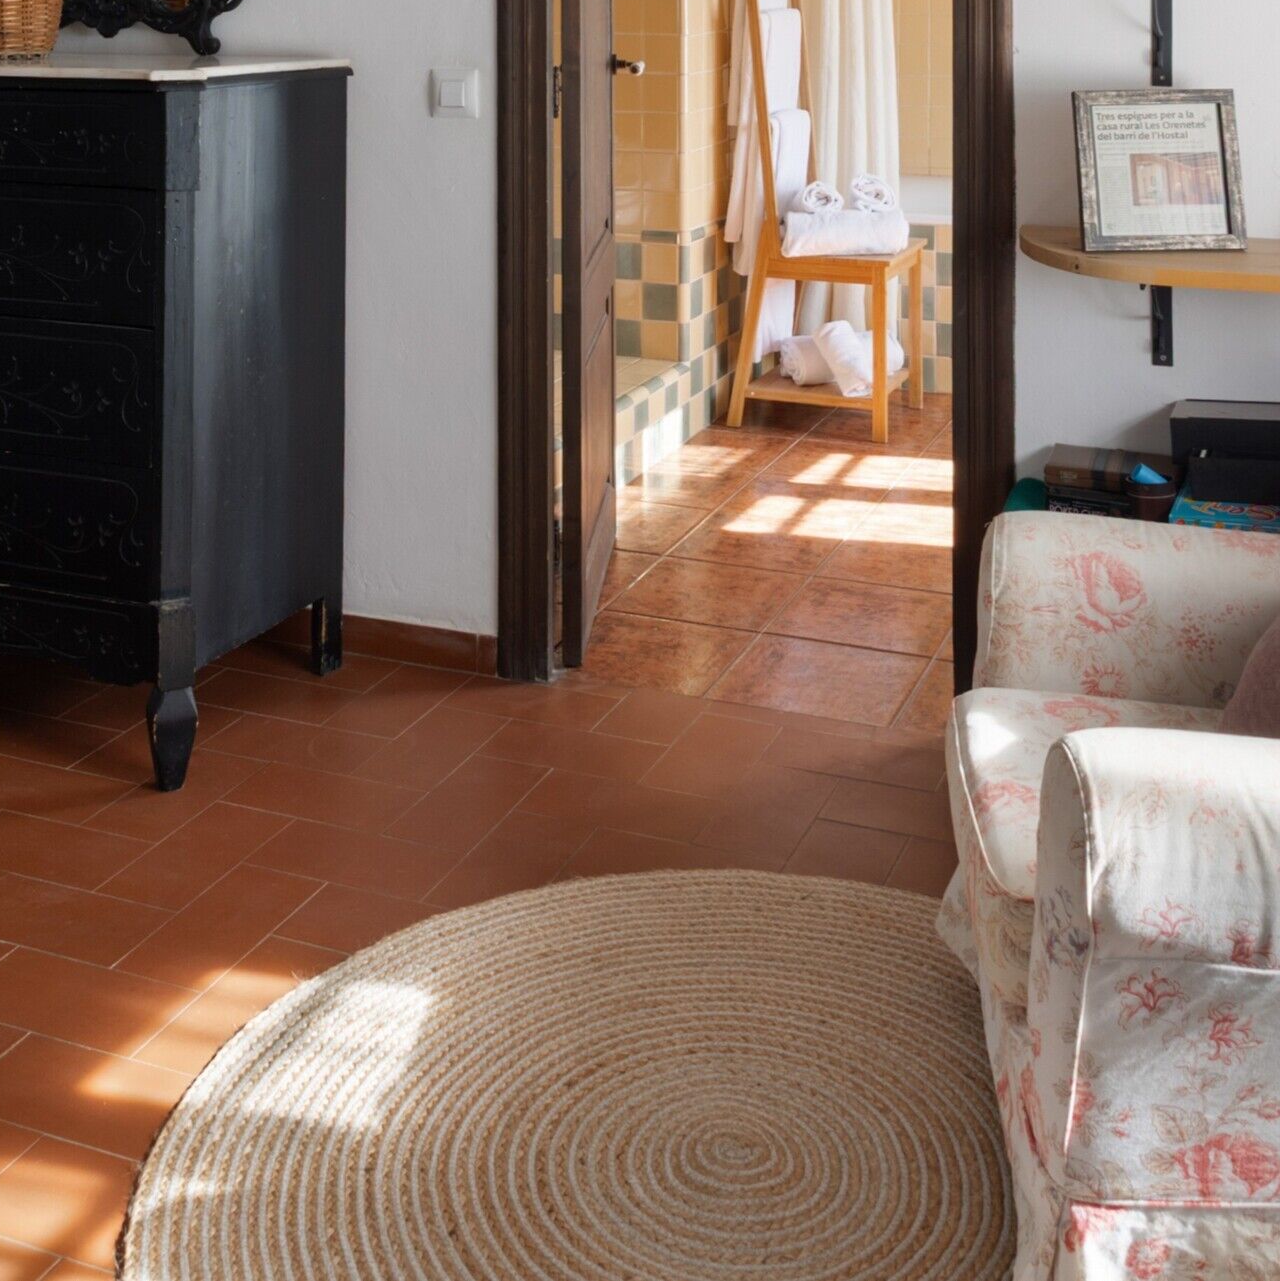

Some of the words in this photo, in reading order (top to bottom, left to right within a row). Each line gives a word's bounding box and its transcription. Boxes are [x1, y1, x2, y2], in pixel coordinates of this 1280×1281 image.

[1096, 112, 1115, 120] Tres
[1118, 111, 1158, 121] espigues
[1160, 112, 1176, 121] per
[1185, 110, 1194, 119] la
[1120, 121, 1143, 130] rural
[1145, 121, 1160, 129] Les
[1097, 132, 1112, 140] del
[1114, 132, 1137, 140] barri
[1139, 132, 1150, 140] de
